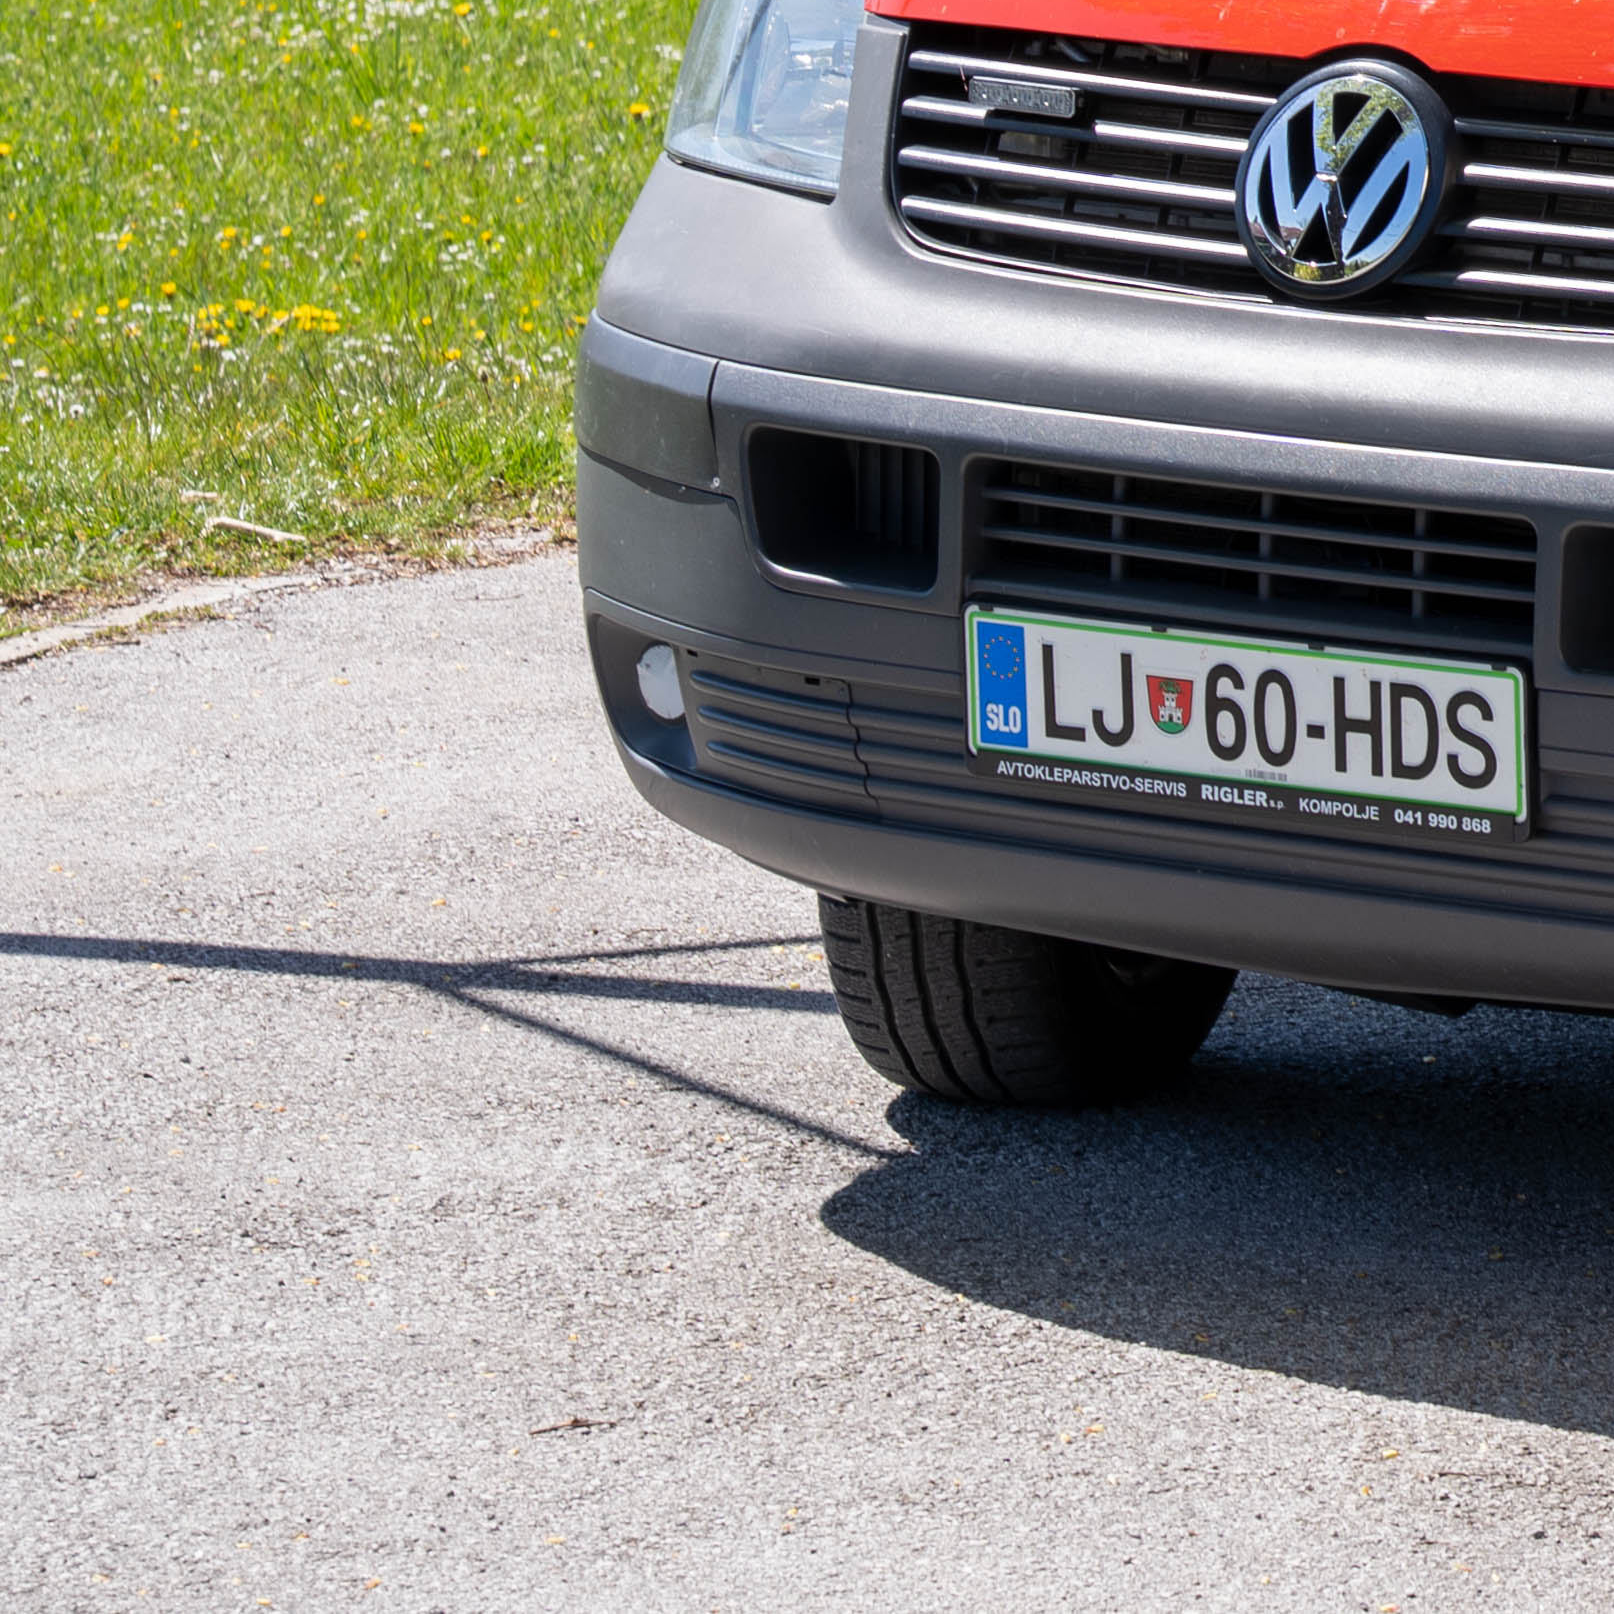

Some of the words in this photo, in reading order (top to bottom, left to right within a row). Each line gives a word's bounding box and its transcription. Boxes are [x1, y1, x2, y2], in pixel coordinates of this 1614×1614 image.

[986, 702, 1022, 734] SLO
[1042, 643, 1134, 747] LJ
[1205, 663, 1497, 790] 60-HDS
[997, 760, 1187, 797] AVTOKLEPARSTVO-SERVIS
[1201, 784, 1268, 808] RIGLER
[1299, 797, 1380, 821] KOMPOLJE
[1394, 808, 1423, 826] 041
[1428, 813, 1458, 830] 990
[1461, 817, 1491, 834] 868
